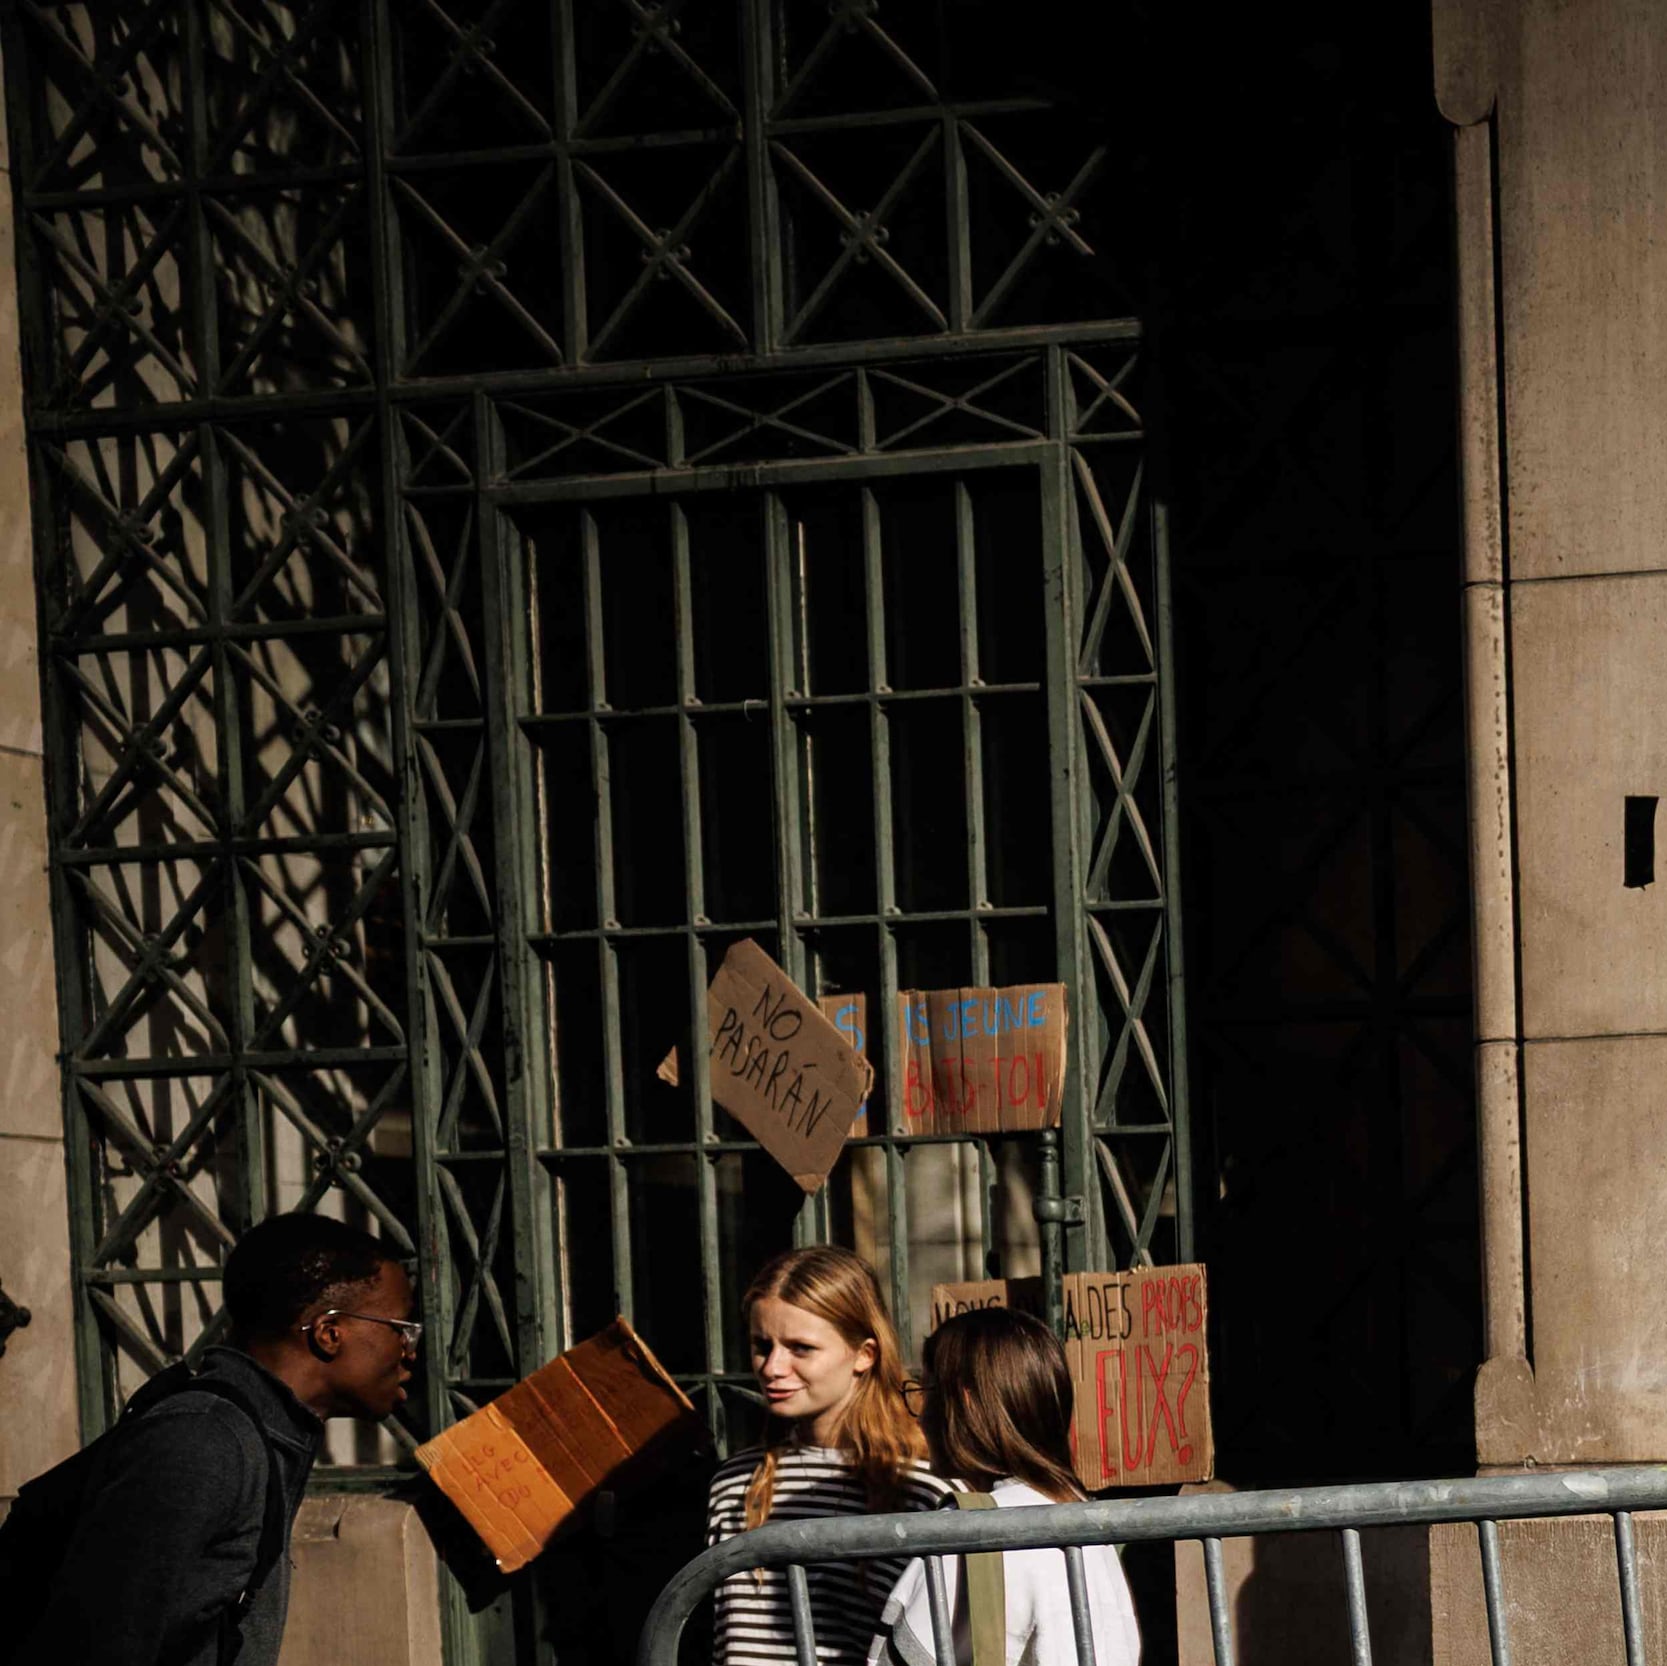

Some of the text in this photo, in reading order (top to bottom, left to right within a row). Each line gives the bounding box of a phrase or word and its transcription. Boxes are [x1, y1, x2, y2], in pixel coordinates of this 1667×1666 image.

[753, 984, 802, 1041] NO
[943, 991, 1048, 1041] JEUNE
[1087, 1284, 1132, 1341] DES
[1142, 1275, 1203, 1338] PROFS
